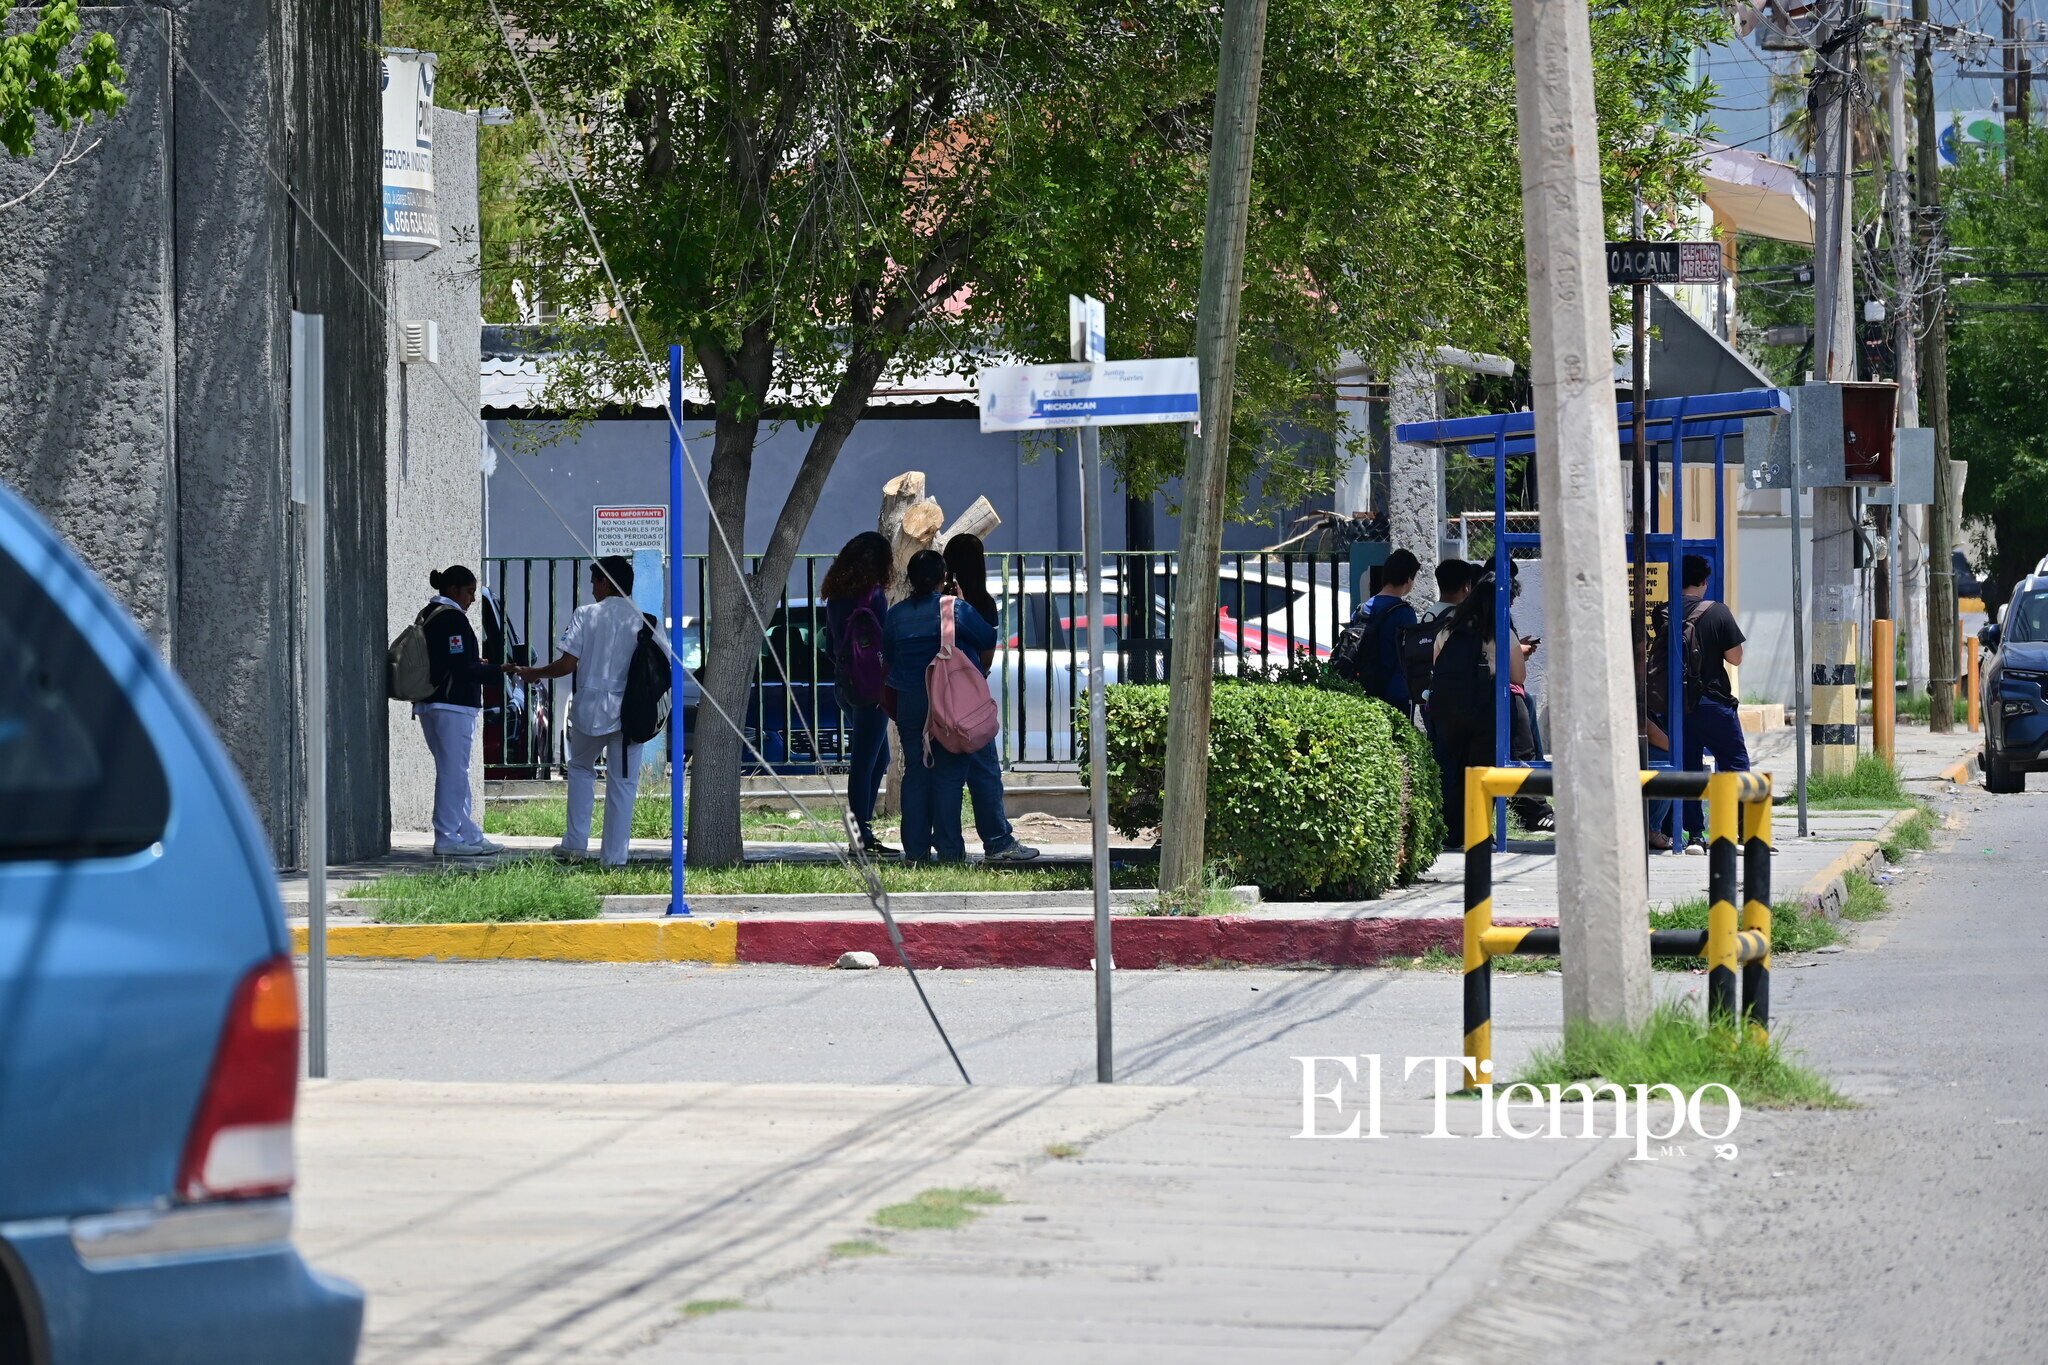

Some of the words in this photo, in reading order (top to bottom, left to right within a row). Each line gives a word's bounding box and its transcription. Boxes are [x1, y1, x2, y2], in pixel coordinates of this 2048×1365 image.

[384, 149, 410, 170] EEDORA
[394, 210, 410, 233] 866
[1606, 251, 1671, 273] OACAN
[1682, 261, 1720, 277] ABREGO
[1043, 388, 1076, 398] CALLE
[1043, 401, 1097, 411] MICHOACAN
